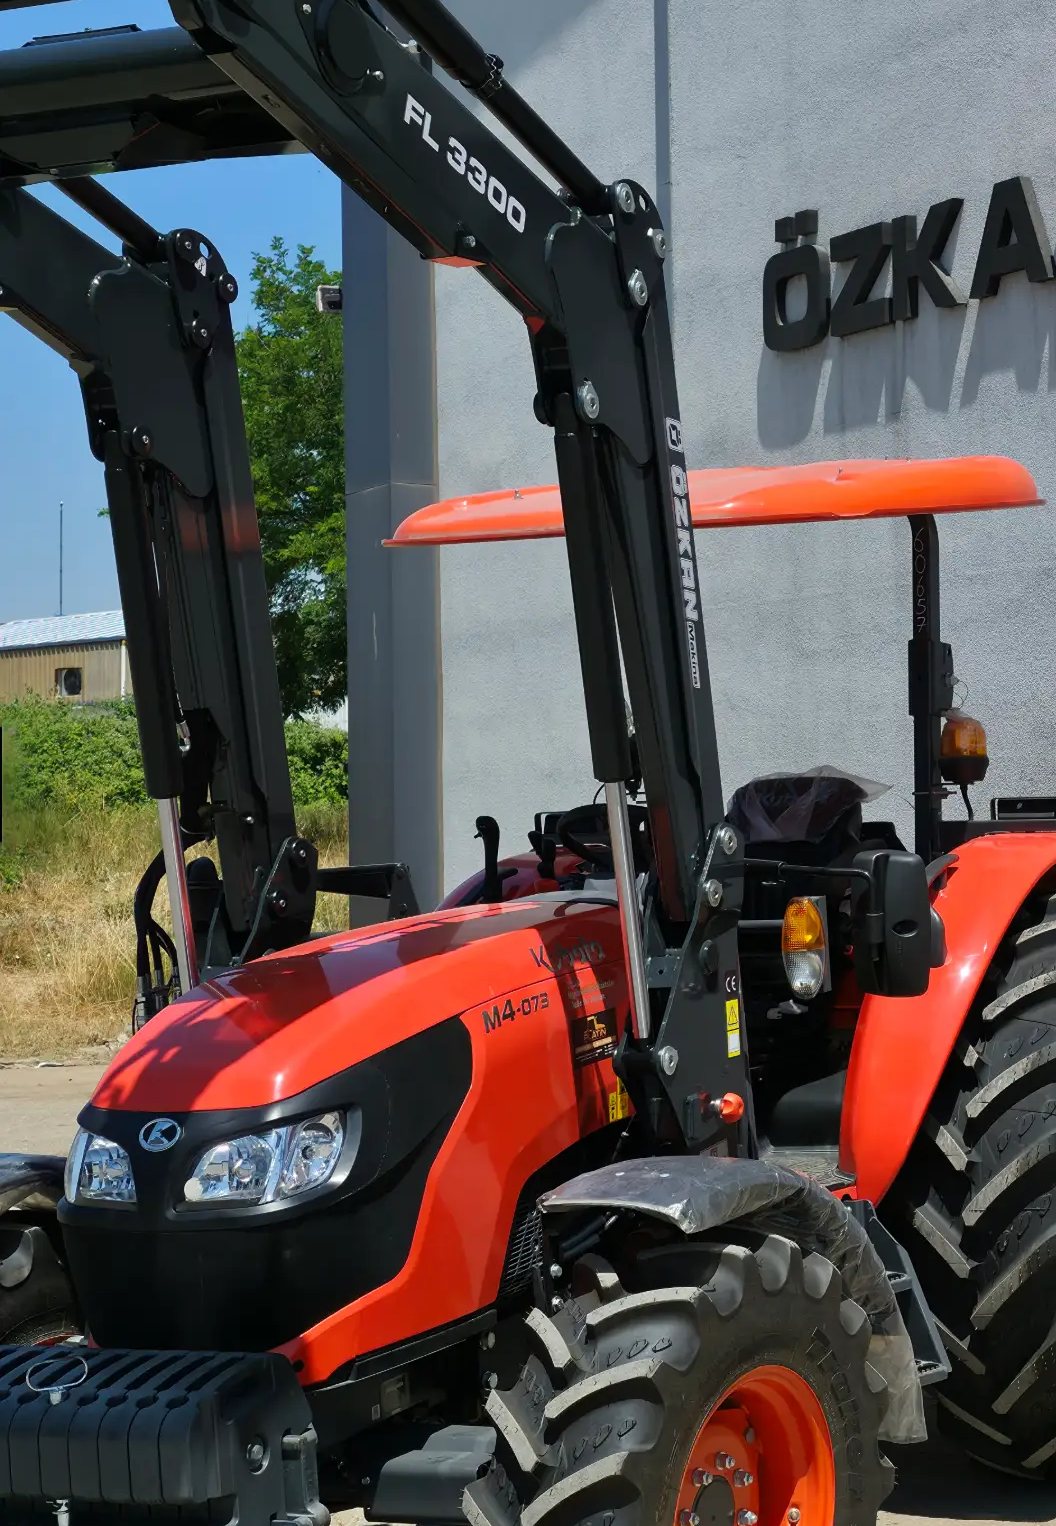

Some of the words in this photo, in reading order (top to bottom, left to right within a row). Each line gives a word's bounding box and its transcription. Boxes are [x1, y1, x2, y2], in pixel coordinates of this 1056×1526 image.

[403, 92, 440, 153] FL
[446, 135, 527, 234] 3300
[481, 992, 549, 1034] M4-073
